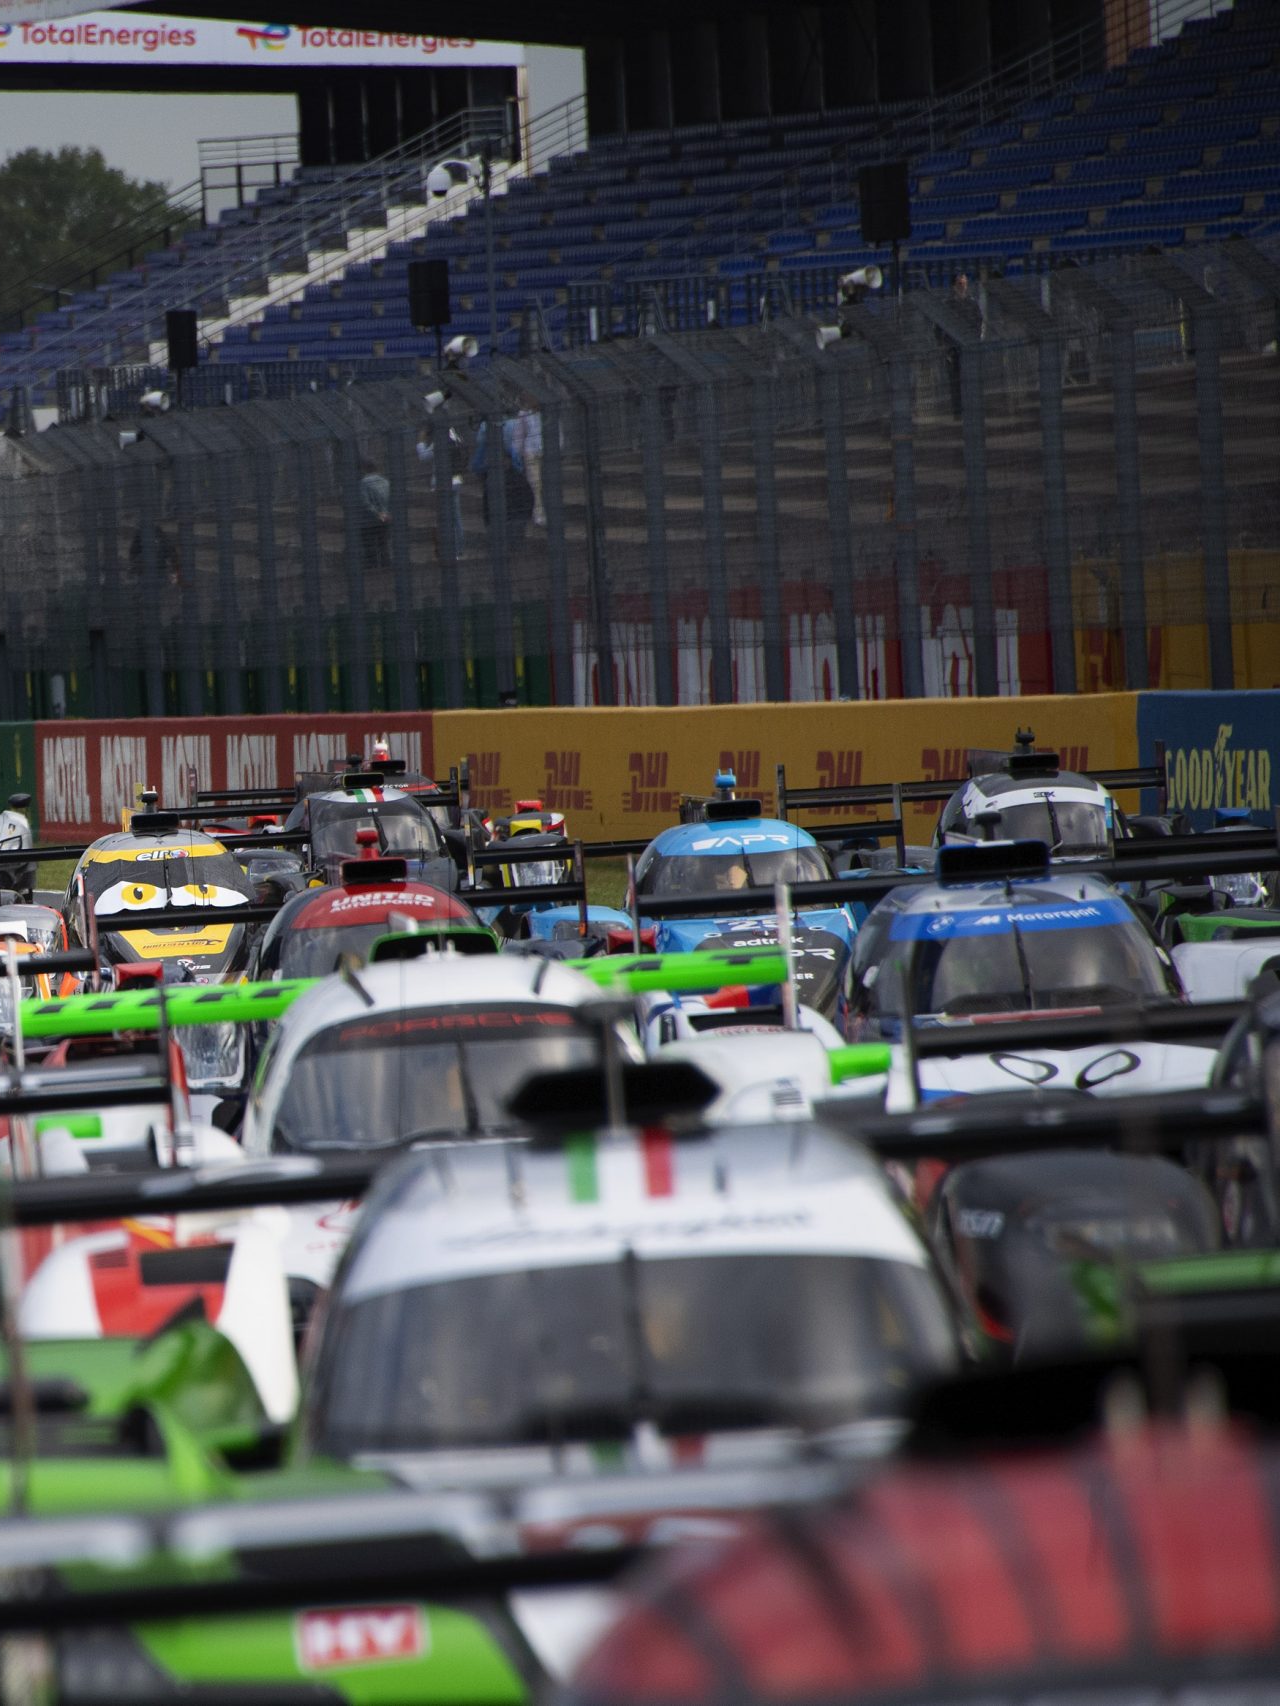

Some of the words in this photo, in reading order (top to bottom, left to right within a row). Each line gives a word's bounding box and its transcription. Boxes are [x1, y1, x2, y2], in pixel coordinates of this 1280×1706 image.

[19, 22, 196, 51] TotalEnergies
[331, 891, 435, 909] UNITED
[1007, 906, 1101, 922] Motorsport
[733, 936, 805, 947] adtrk
[339, 1011, 576, 1041] PORSCHE
